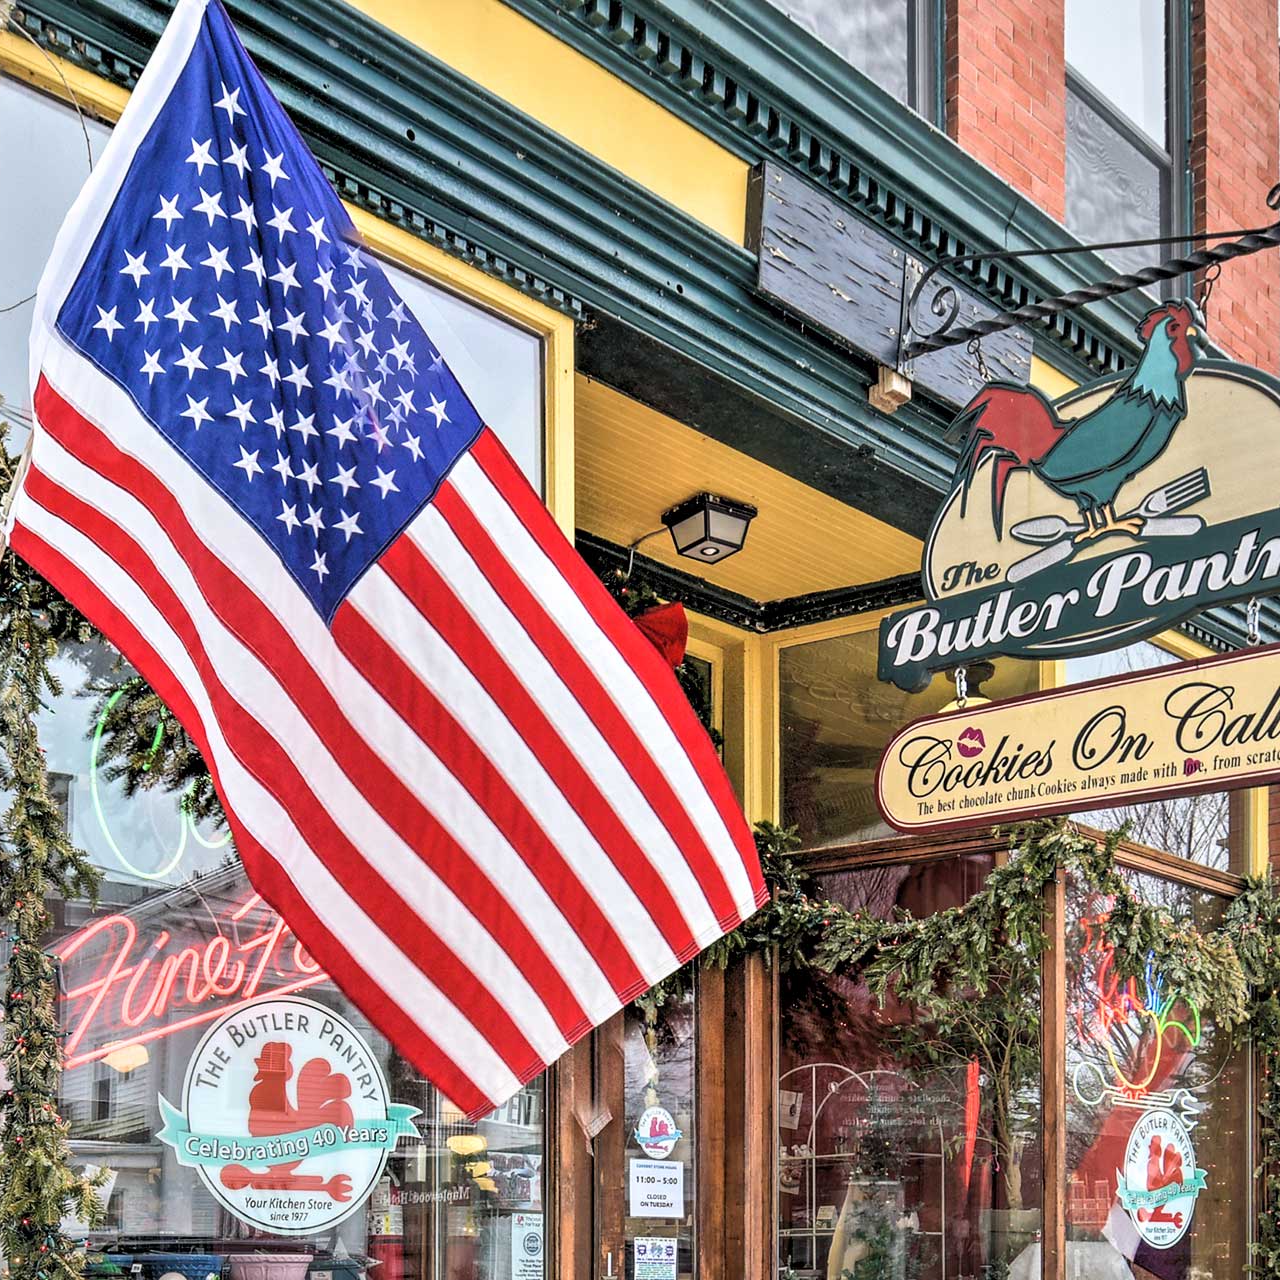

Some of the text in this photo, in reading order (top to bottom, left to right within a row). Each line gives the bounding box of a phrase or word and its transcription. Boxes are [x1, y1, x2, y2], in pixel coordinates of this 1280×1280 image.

[941, 561, 1001, 592] The
[886, 586, 1079, 667] Butler
[898, 735, 1056, 798] Cookies
[1072, 704, 1154, 772] On
[917, 802, 933, 816] The
[937, 798, 956, 813] best
[959, 791, 1003, 809] chocolate
[1006, 786, 1036, 801] chunk
[1037, 779, 1077, 797] Cookies
[1081, 774, 1116, 791] always
[1120, 768, 1148, 784] made
[1153, 764, 1177, 779] with
[1183, 758, 1208, 775] love,
[1213, 754, 1241, 771] from
[60, 914, 245, 1055] Fine
[195, 1012, 378, 1102] THE BUTLER PANTRY
[185, 1125, 388, 1161] Celebrating 40 Years
[1128, 1118, 1192, 1168] THE BUTLER PANTRY
[244, 1197, 333, 1210] Your Kitchen Store
[636, 1176, 655, 1184] 11:00
[270, 1212, 308, 1222] since 1977
